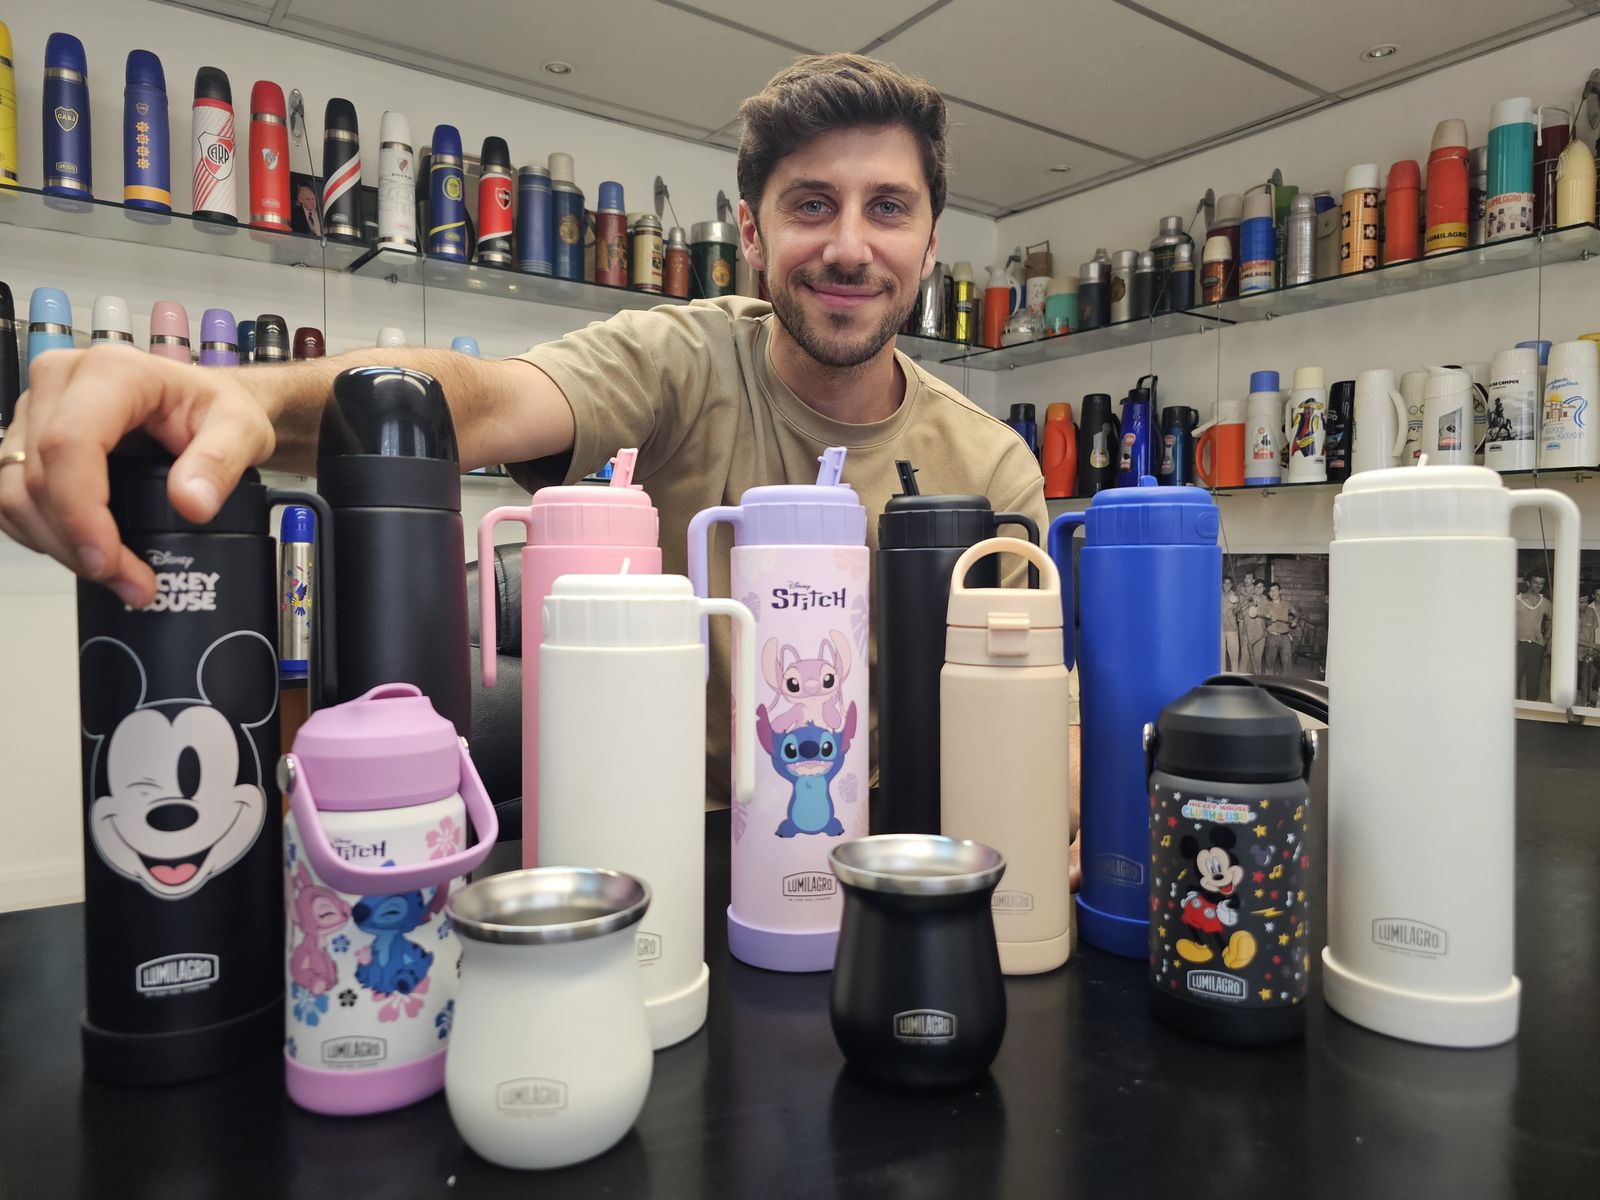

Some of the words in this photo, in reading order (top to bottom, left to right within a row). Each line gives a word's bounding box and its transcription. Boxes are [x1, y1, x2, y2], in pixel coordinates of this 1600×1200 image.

[1426, 231, 1468, 243] LUMILAGRO
[155, 571, 221, 592] CKEY
[787, 876, 832, 893] LUMILAGRO
[1379, 923, 1439, 949] LUMILAGRO
[143, 959, 212, 986] LUMILAGRO
[1191, 974, 1240, 995] LUMILAGRO
[900, 1015, 950, 1035] LUMILAGRO
